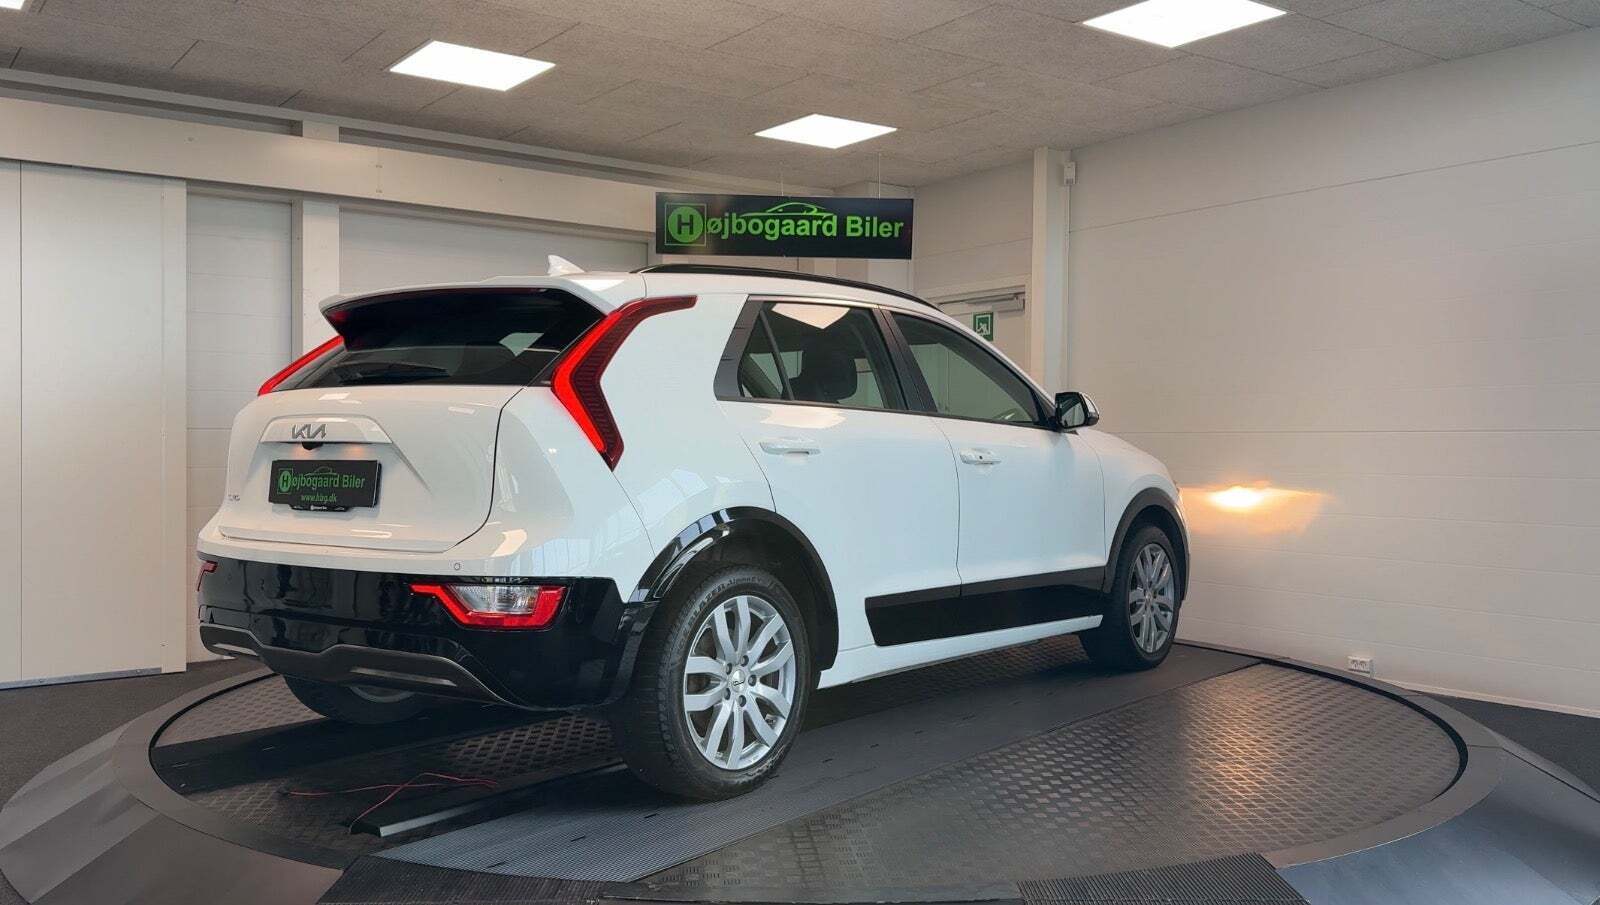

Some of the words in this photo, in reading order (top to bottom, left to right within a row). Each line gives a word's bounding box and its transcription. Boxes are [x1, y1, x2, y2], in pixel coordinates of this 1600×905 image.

[668, 206, 838, 242] Højbogaard
[846, 215, 905, 238] Biler
[292, 423, 326, 439] KIA
[342, 474, 366, 489] Biler
